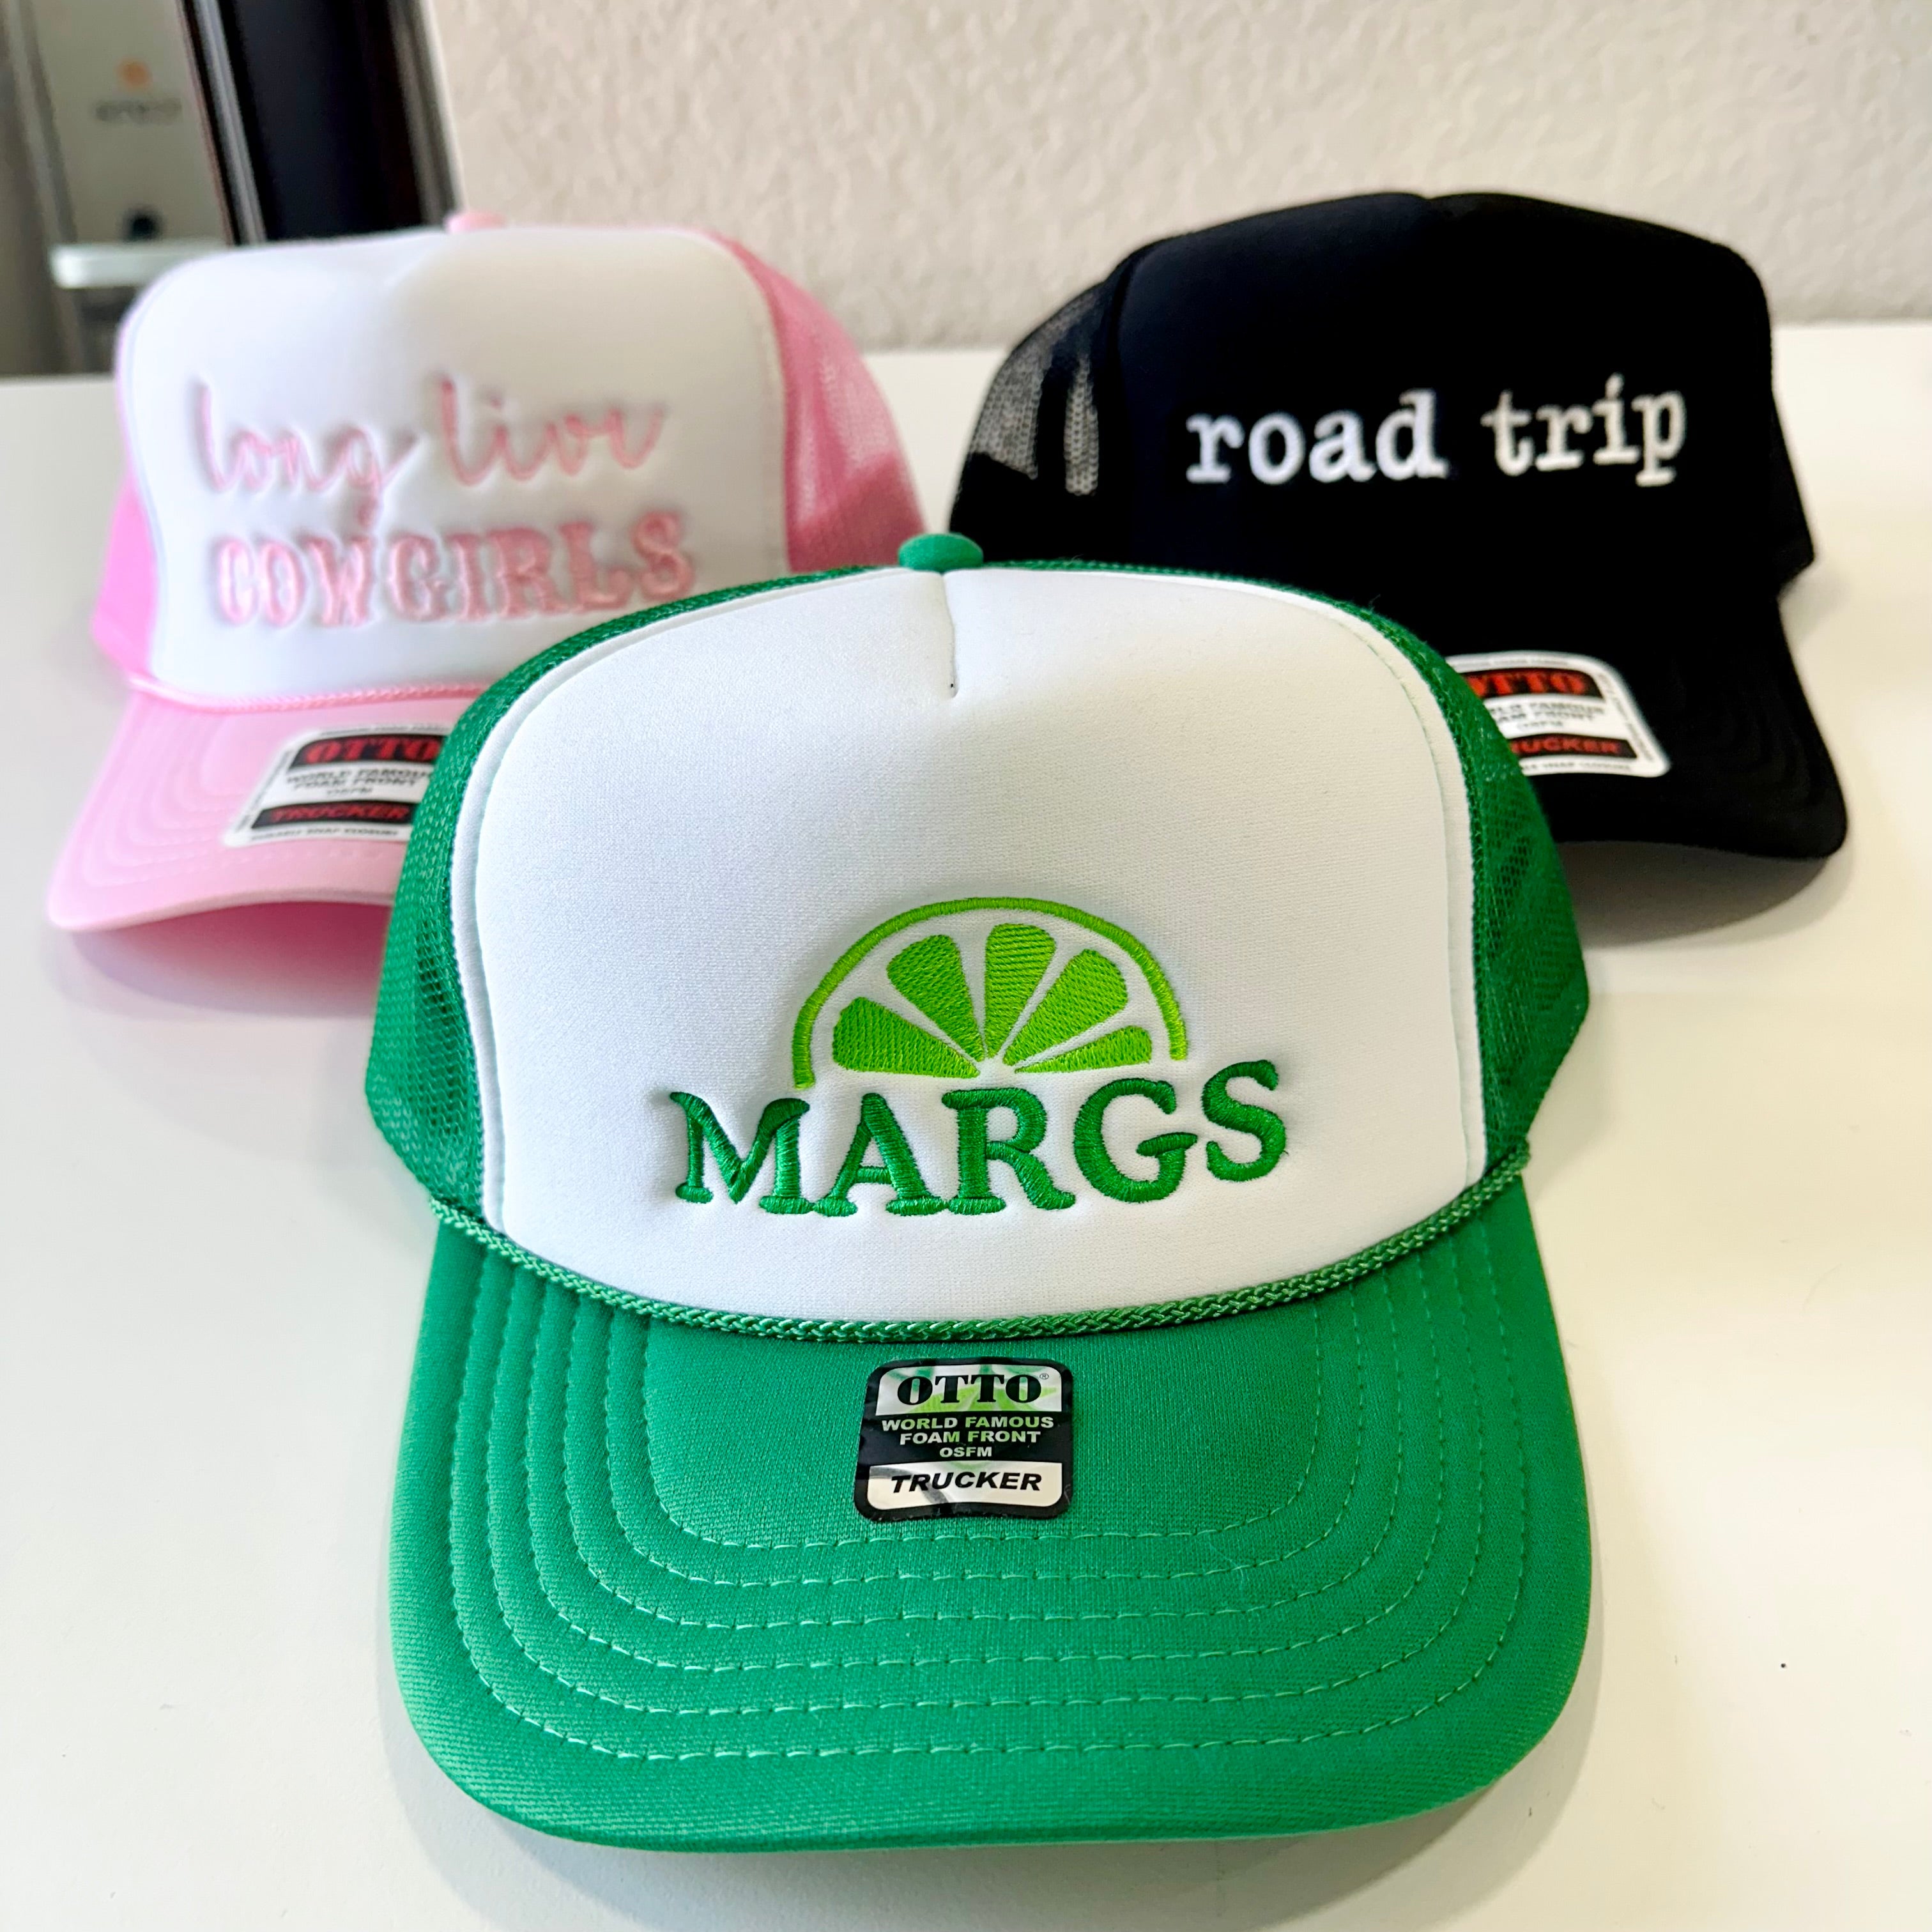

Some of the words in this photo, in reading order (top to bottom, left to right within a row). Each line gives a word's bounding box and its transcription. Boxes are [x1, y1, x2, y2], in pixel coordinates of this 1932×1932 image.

[1186, 388, 1450, 486] road
[1480, 372, 1687, 487] trip
[197, 378, 420, 529] long
[216, 512, 696, 629] COWGIRLS
[305, 737, 441, 765] OTTO
[1510, 737, 1619, 755] UCKER
[357, 768, 434, 779] FAMOU
[271, 802, 410, 824] TRUCKER
[670, 1059, 1287, 1218] MARGS
[882, 1416, 958, 1432] WORLD
[965, 1416, 1054, 1429] FAMOUS
[900, 1430, 960, 1445] FOAM
[967, 1430, 1041, 1443] FRONT
[939, 1446, 992, 1458] OSFM
[891, 1471, 1042, 1494] TRUCKER
